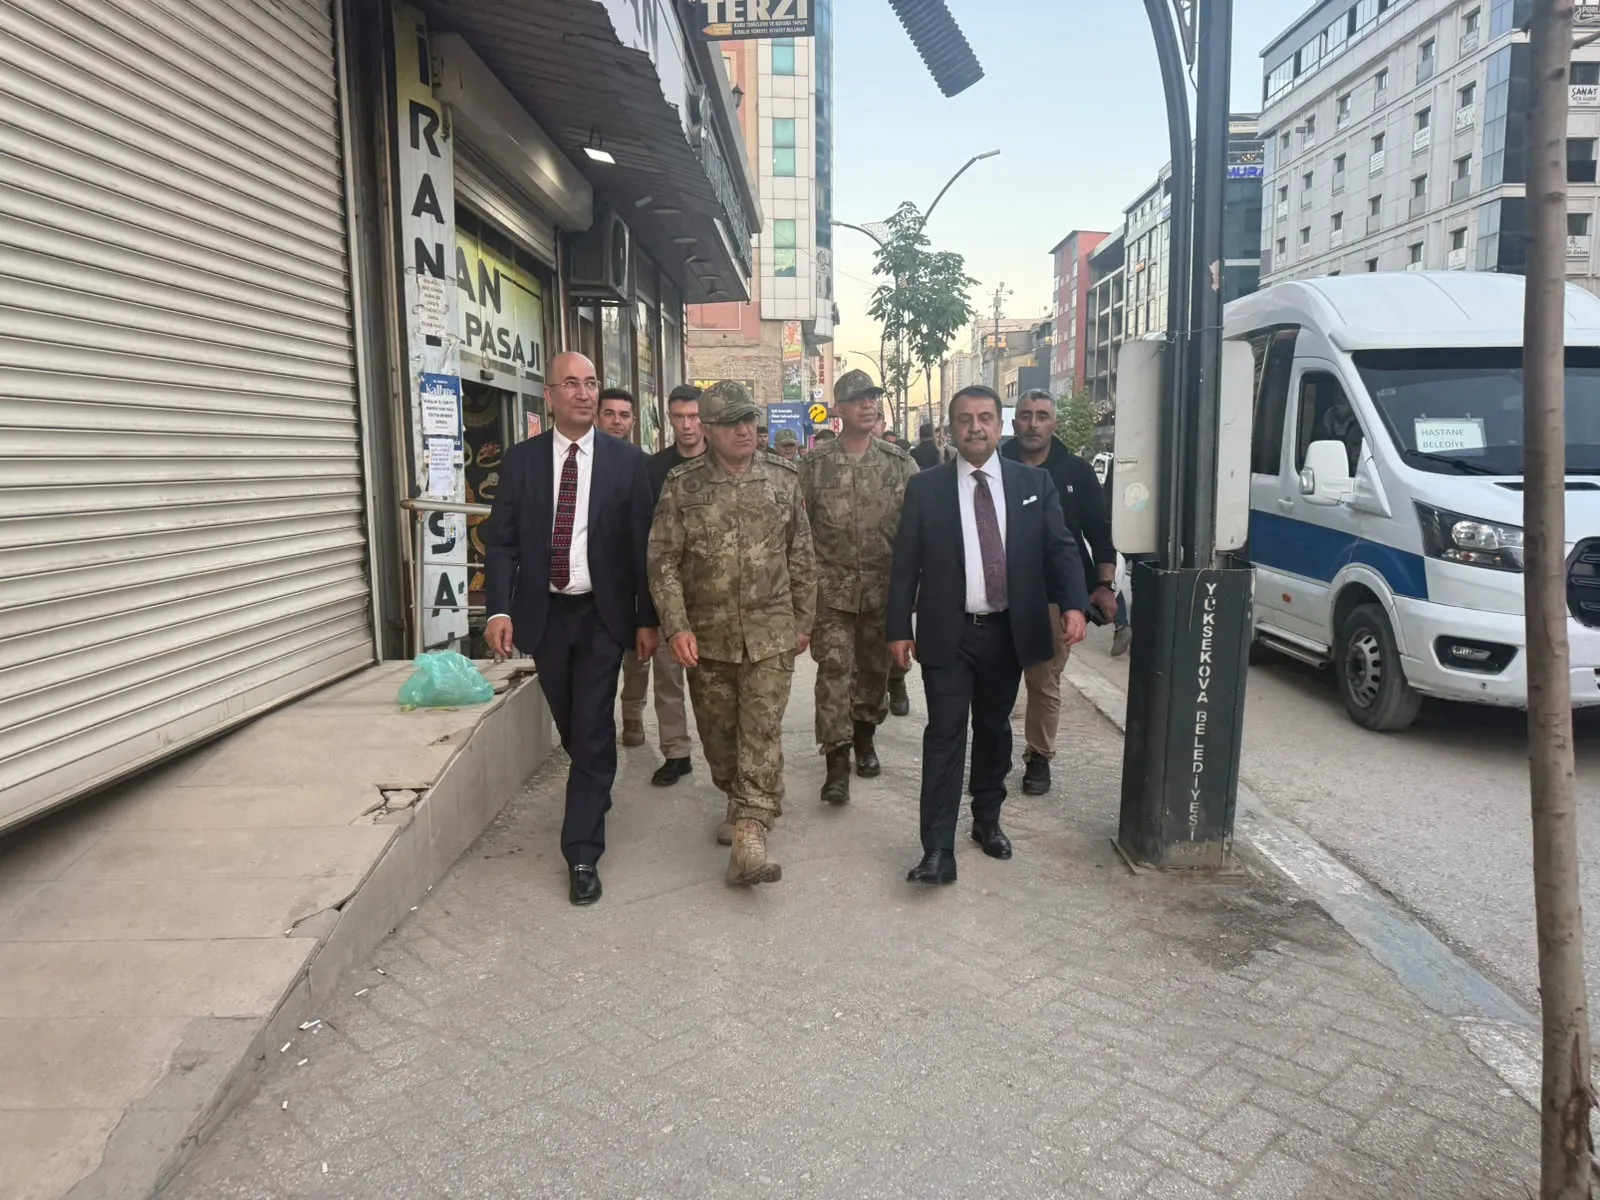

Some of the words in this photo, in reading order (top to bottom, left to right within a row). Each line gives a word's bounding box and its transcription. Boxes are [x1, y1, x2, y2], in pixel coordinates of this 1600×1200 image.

[1571, 87, 1598, 97] SANAT
[1421, 428, 1464, 437] HASTANE
[1423, 439, 1465, 448] BELEDİYE
[1196, 582, 1218, 704] YÜKSEKOVA
[1188, 710, 1208, 841] BELEDİYESİ
